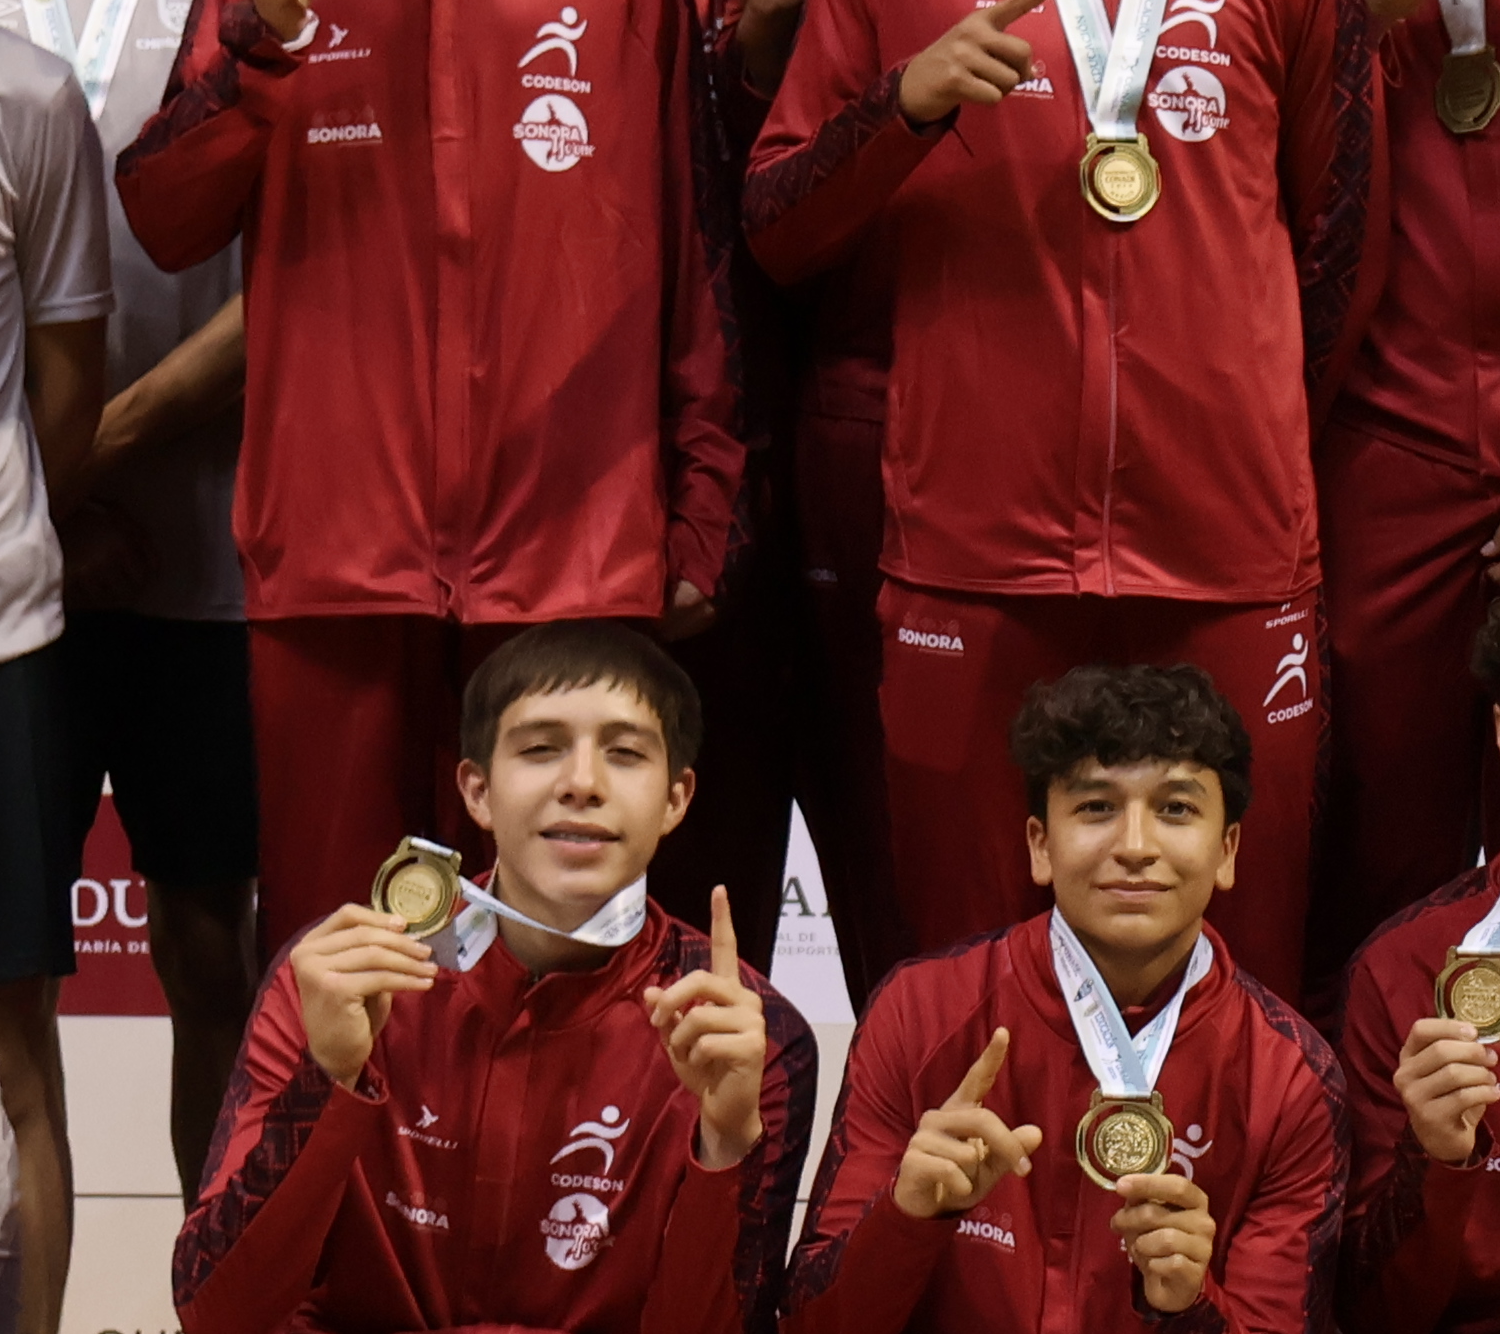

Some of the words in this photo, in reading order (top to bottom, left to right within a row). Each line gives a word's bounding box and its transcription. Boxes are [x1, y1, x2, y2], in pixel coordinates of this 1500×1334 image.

[1156, 46, 1231, 67] CODESON
[520, 74, 592, 95] CODESON
[1147, 91, 1219, 114] SONORA
[307, 123, 383, 145] SONORA
[513, 124, 581, 143] SONORA
[897, 626, 965, 651] SONORA
[551, 1172, 625, 1194] CODESON
[540, 1223, 604, 1245] SONORA
